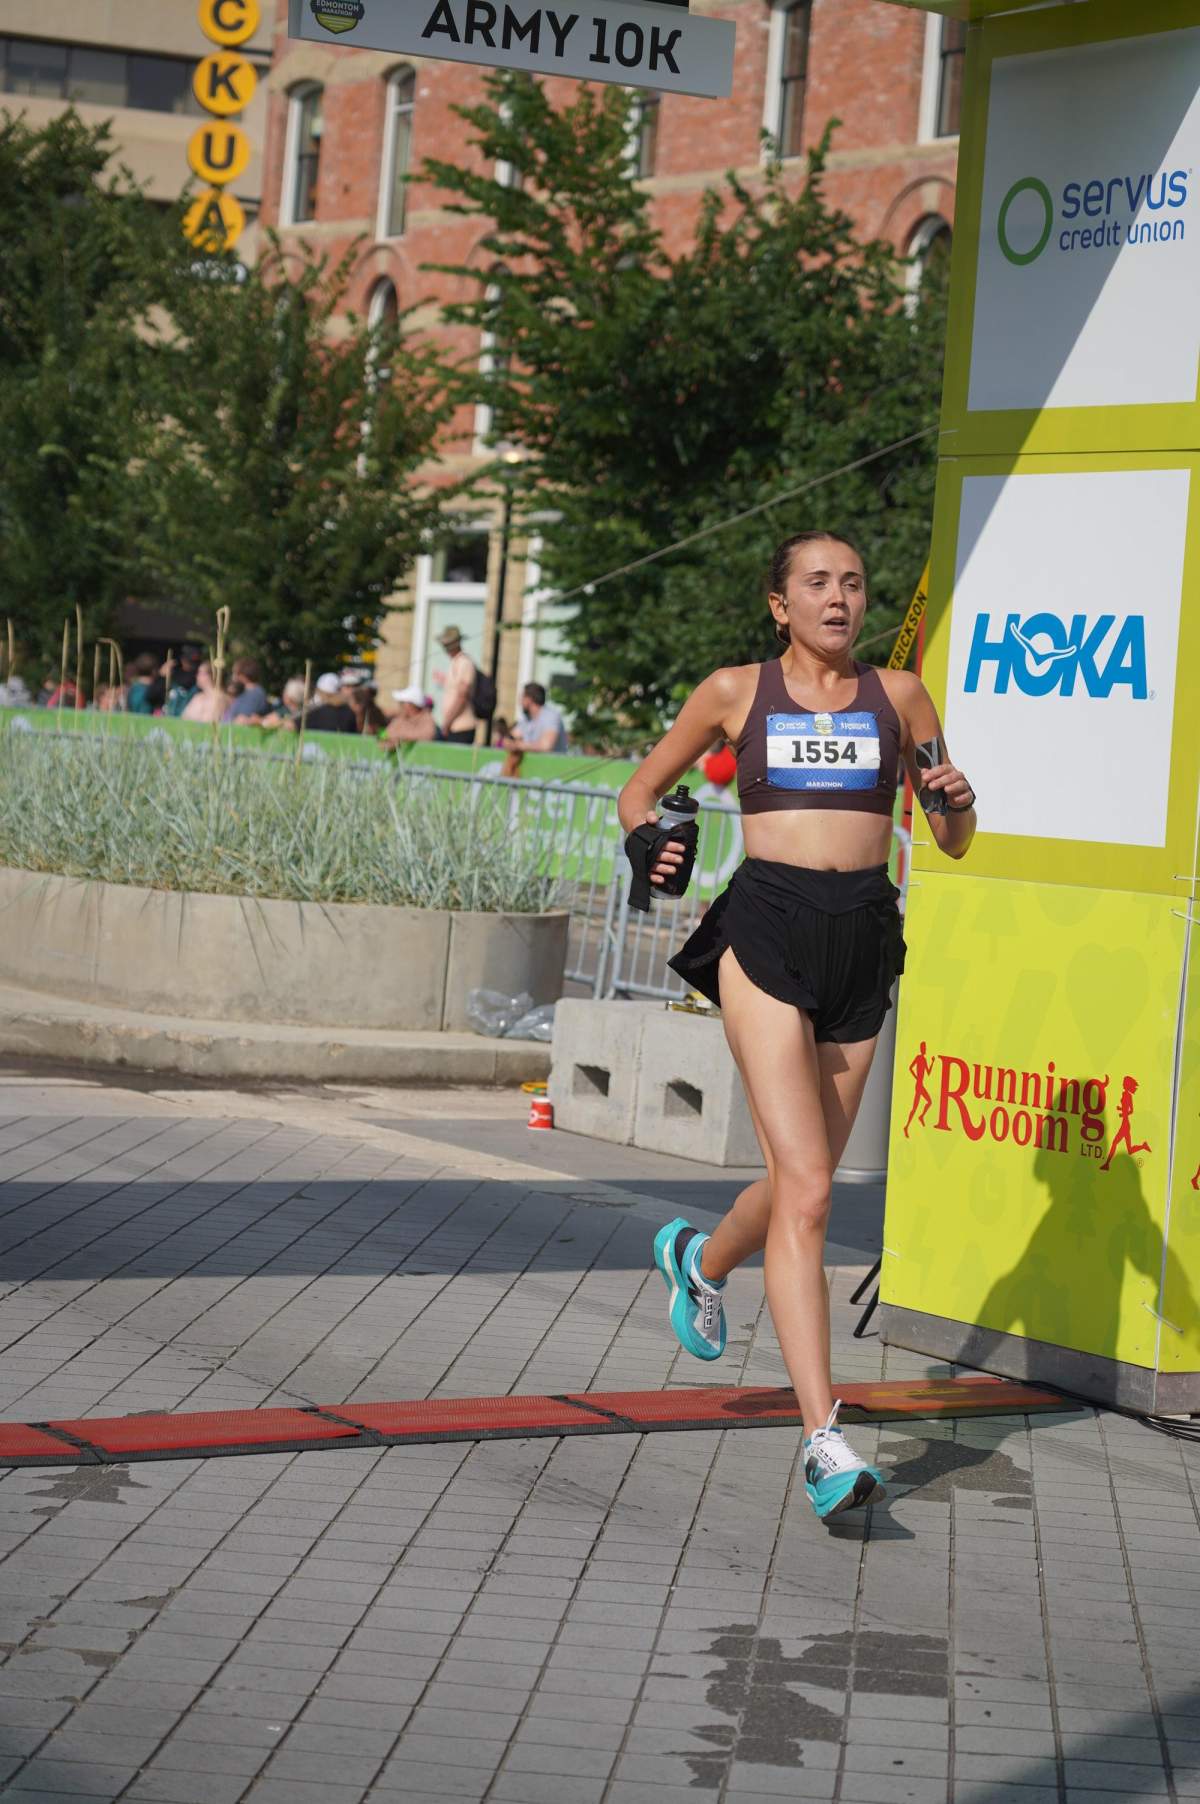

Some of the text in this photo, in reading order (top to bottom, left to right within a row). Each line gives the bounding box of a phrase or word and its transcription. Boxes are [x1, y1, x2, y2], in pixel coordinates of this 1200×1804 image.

[421, 0, 682, 74] ARMY 10K
[1061, 170, 1188, 219] servus
[1059, 219, 1185, 251] credit union
[890, 591, 927, 670] ERICKSON
[963, 612, 1148, 700] HOKA
[791, 740, 858, 764] 1554
[933, 1054, 1109, 1142] Running
